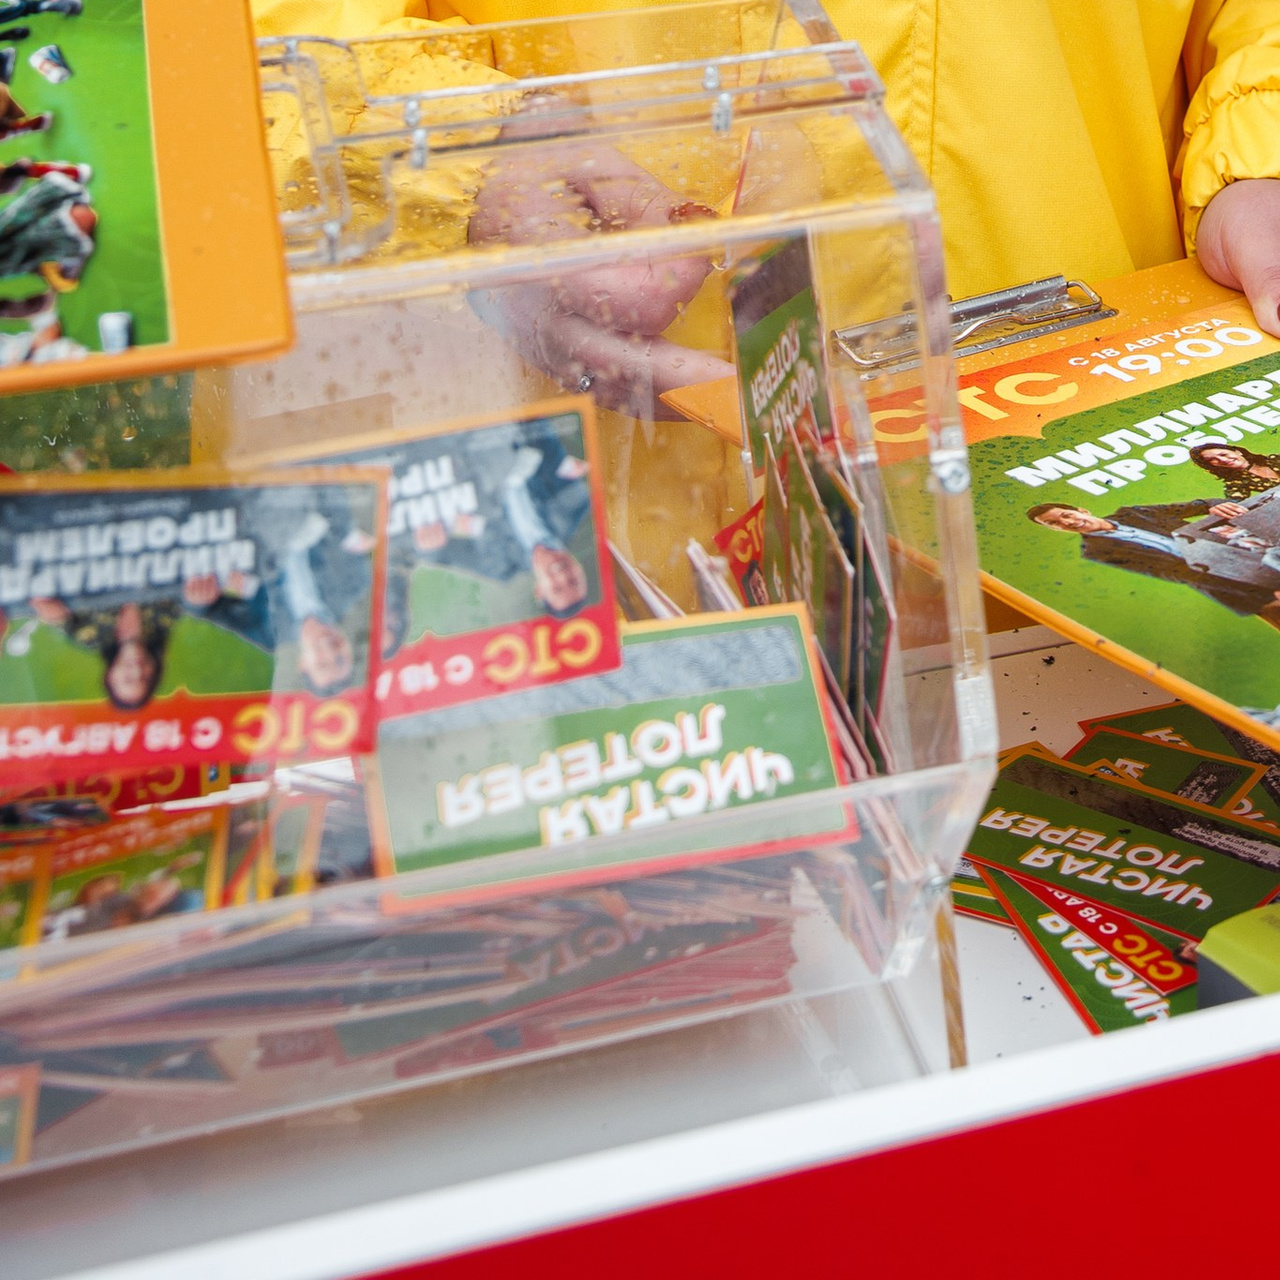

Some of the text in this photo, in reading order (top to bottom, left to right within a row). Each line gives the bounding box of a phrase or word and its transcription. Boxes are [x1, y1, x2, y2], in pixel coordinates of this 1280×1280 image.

[1068, 318, 1230, 367] С 18 АВГУСТА
[1090, 326, 1263, 383] 19:00
[17, 508, 237, 562] ПРОБЛЕМ
[443, 653, 475, 686] С
[482, 618, 603, 685] СТС
[190, 716, 223, 750] С
[231, 699, 360, 755] СТС
[436, 702, 727, 829] ЛОТЕРЕЯ
[539, 746, 794, 848] ЧИСТАЯ
[979, 807, 1205, 875] ЛОТЕРЕЯ
[1020, 845, 1213, 911] ЧИСТАЯ
[1077, 906, 1184, 982] СТС С 18
